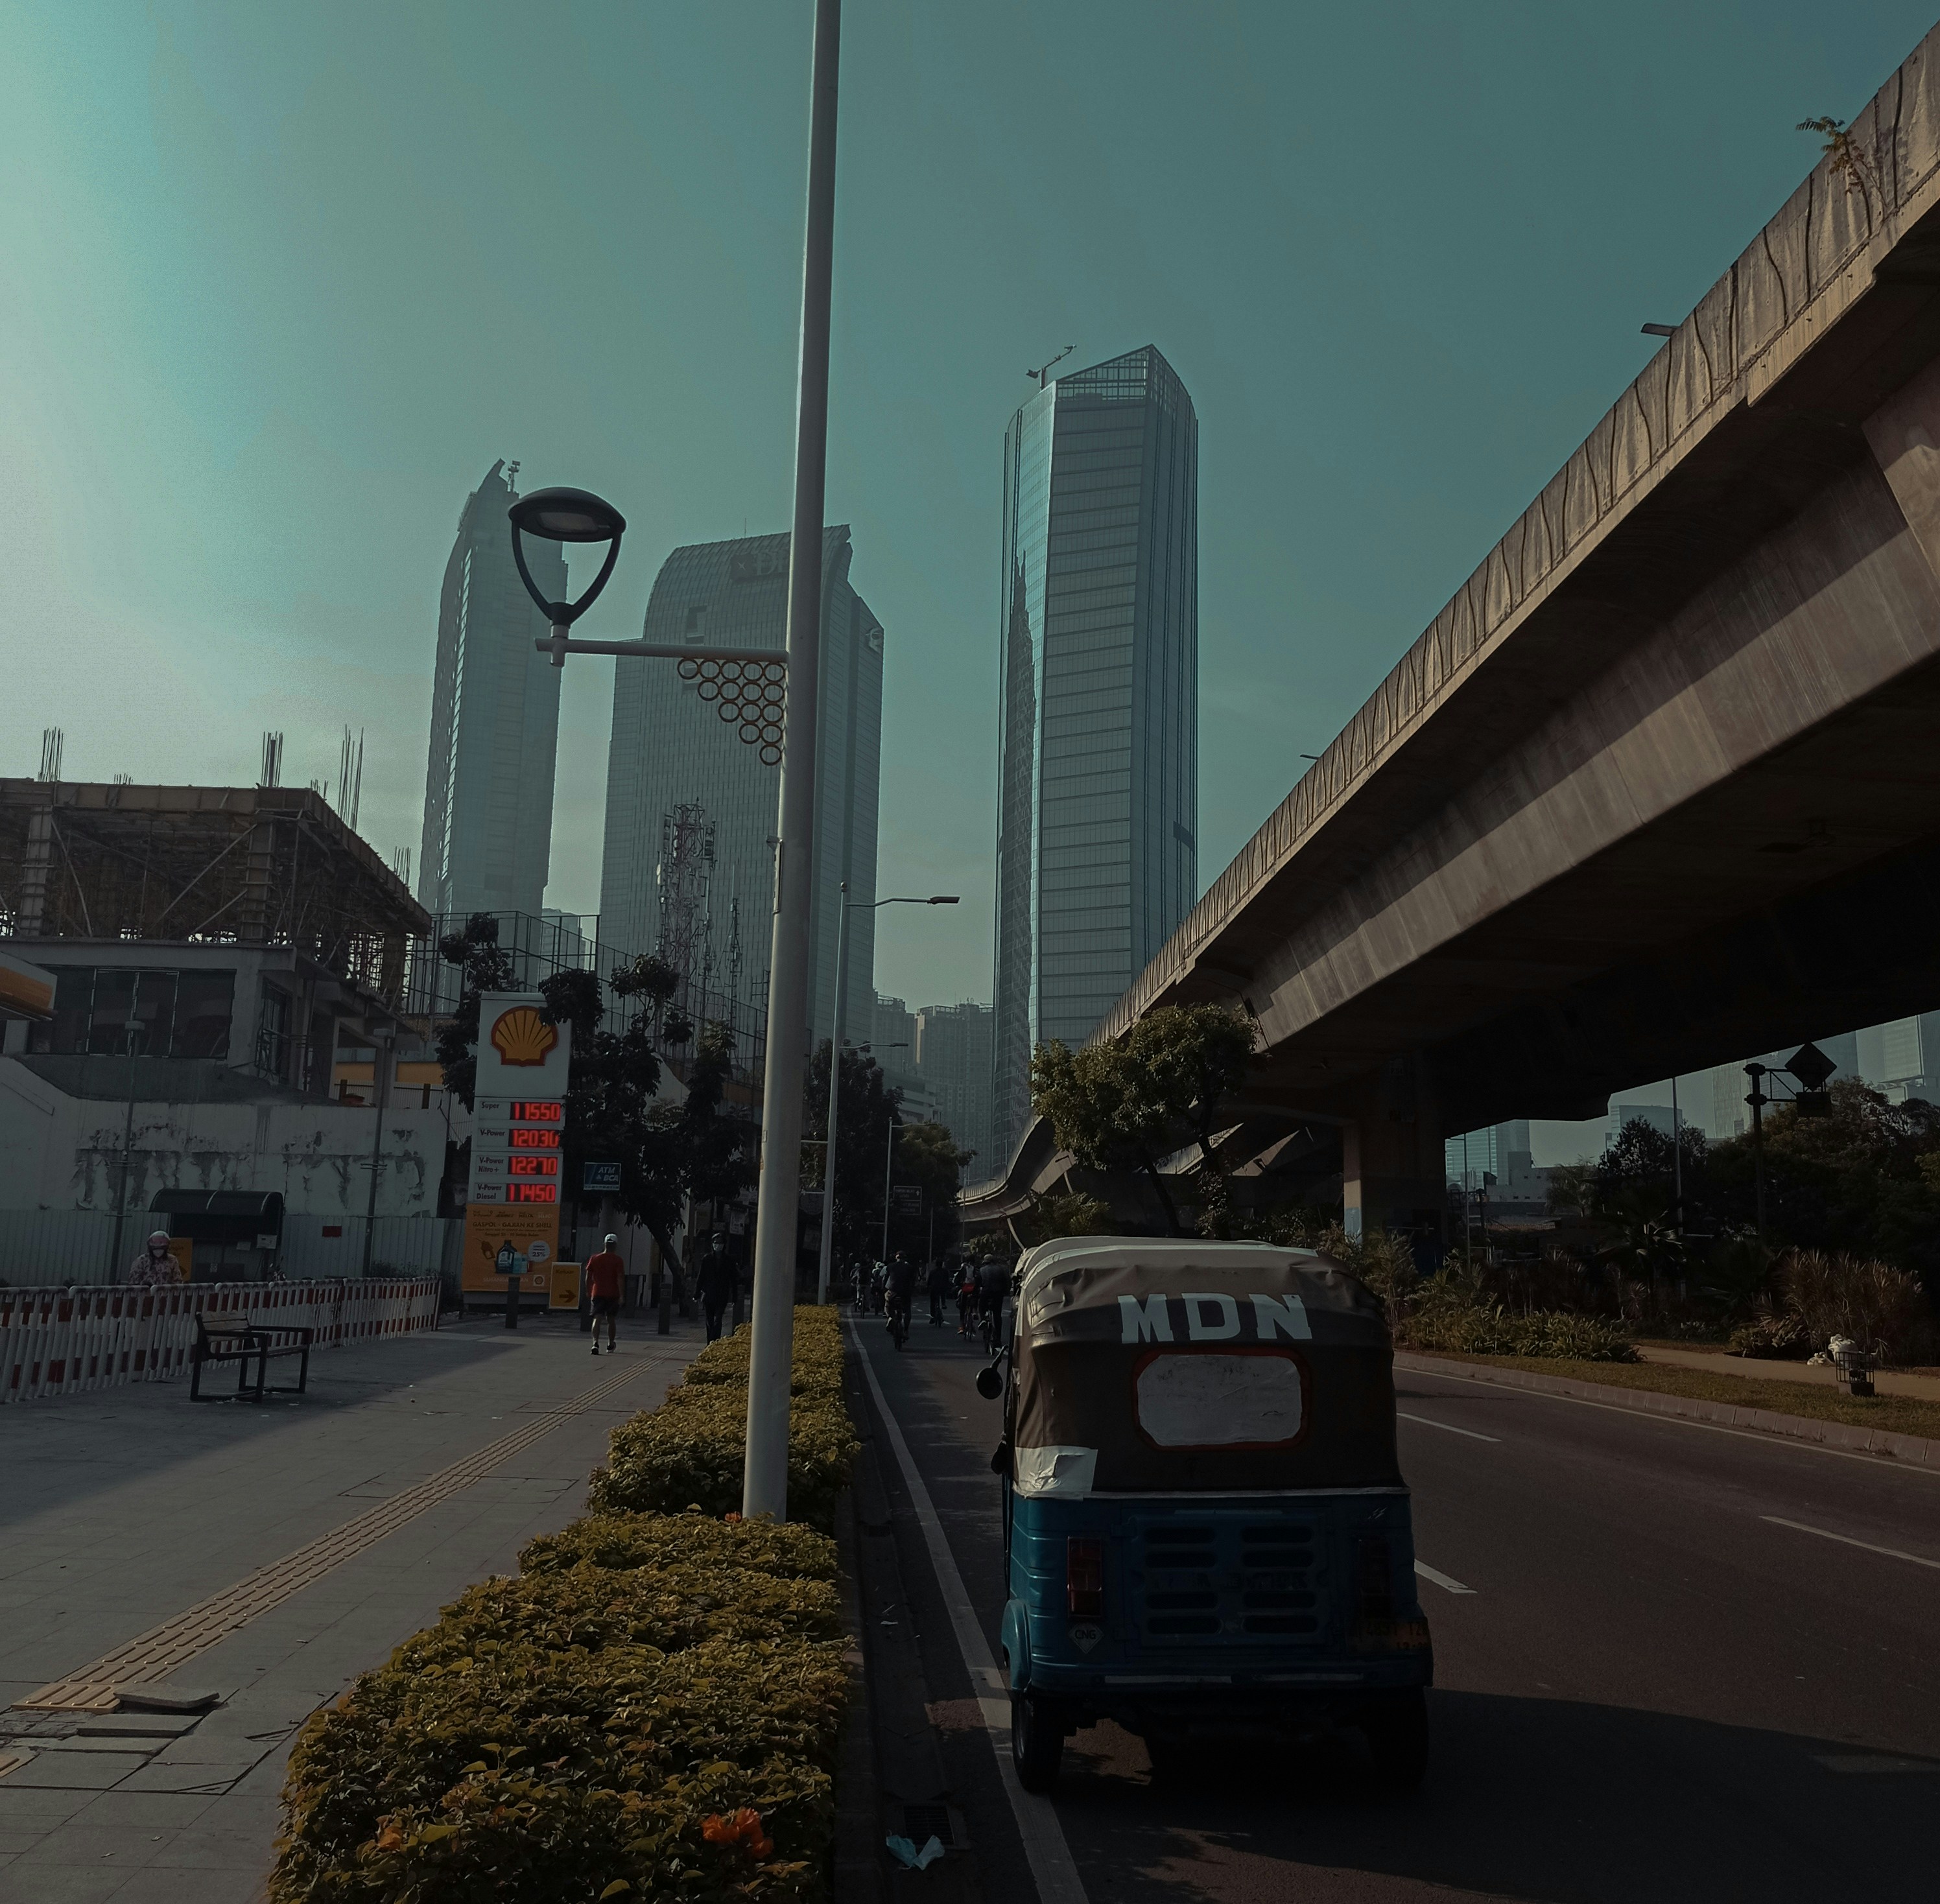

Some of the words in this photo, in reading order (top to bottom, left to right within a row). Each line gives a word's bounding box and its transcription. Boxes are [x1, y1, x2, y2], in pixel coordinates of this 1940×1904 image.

[481, 1101, 499, 1110] Super
[514, 1102, 560, 1120] 11550
[513, 1129, 560, 1147] 12030
[511, 1157, 558, 1174] 12270
[508, 1184, 556, 1202] 11450
[1117, 1292, 1313, 1345] MDN
[1075, 1629, 1096, 1640] CNG
